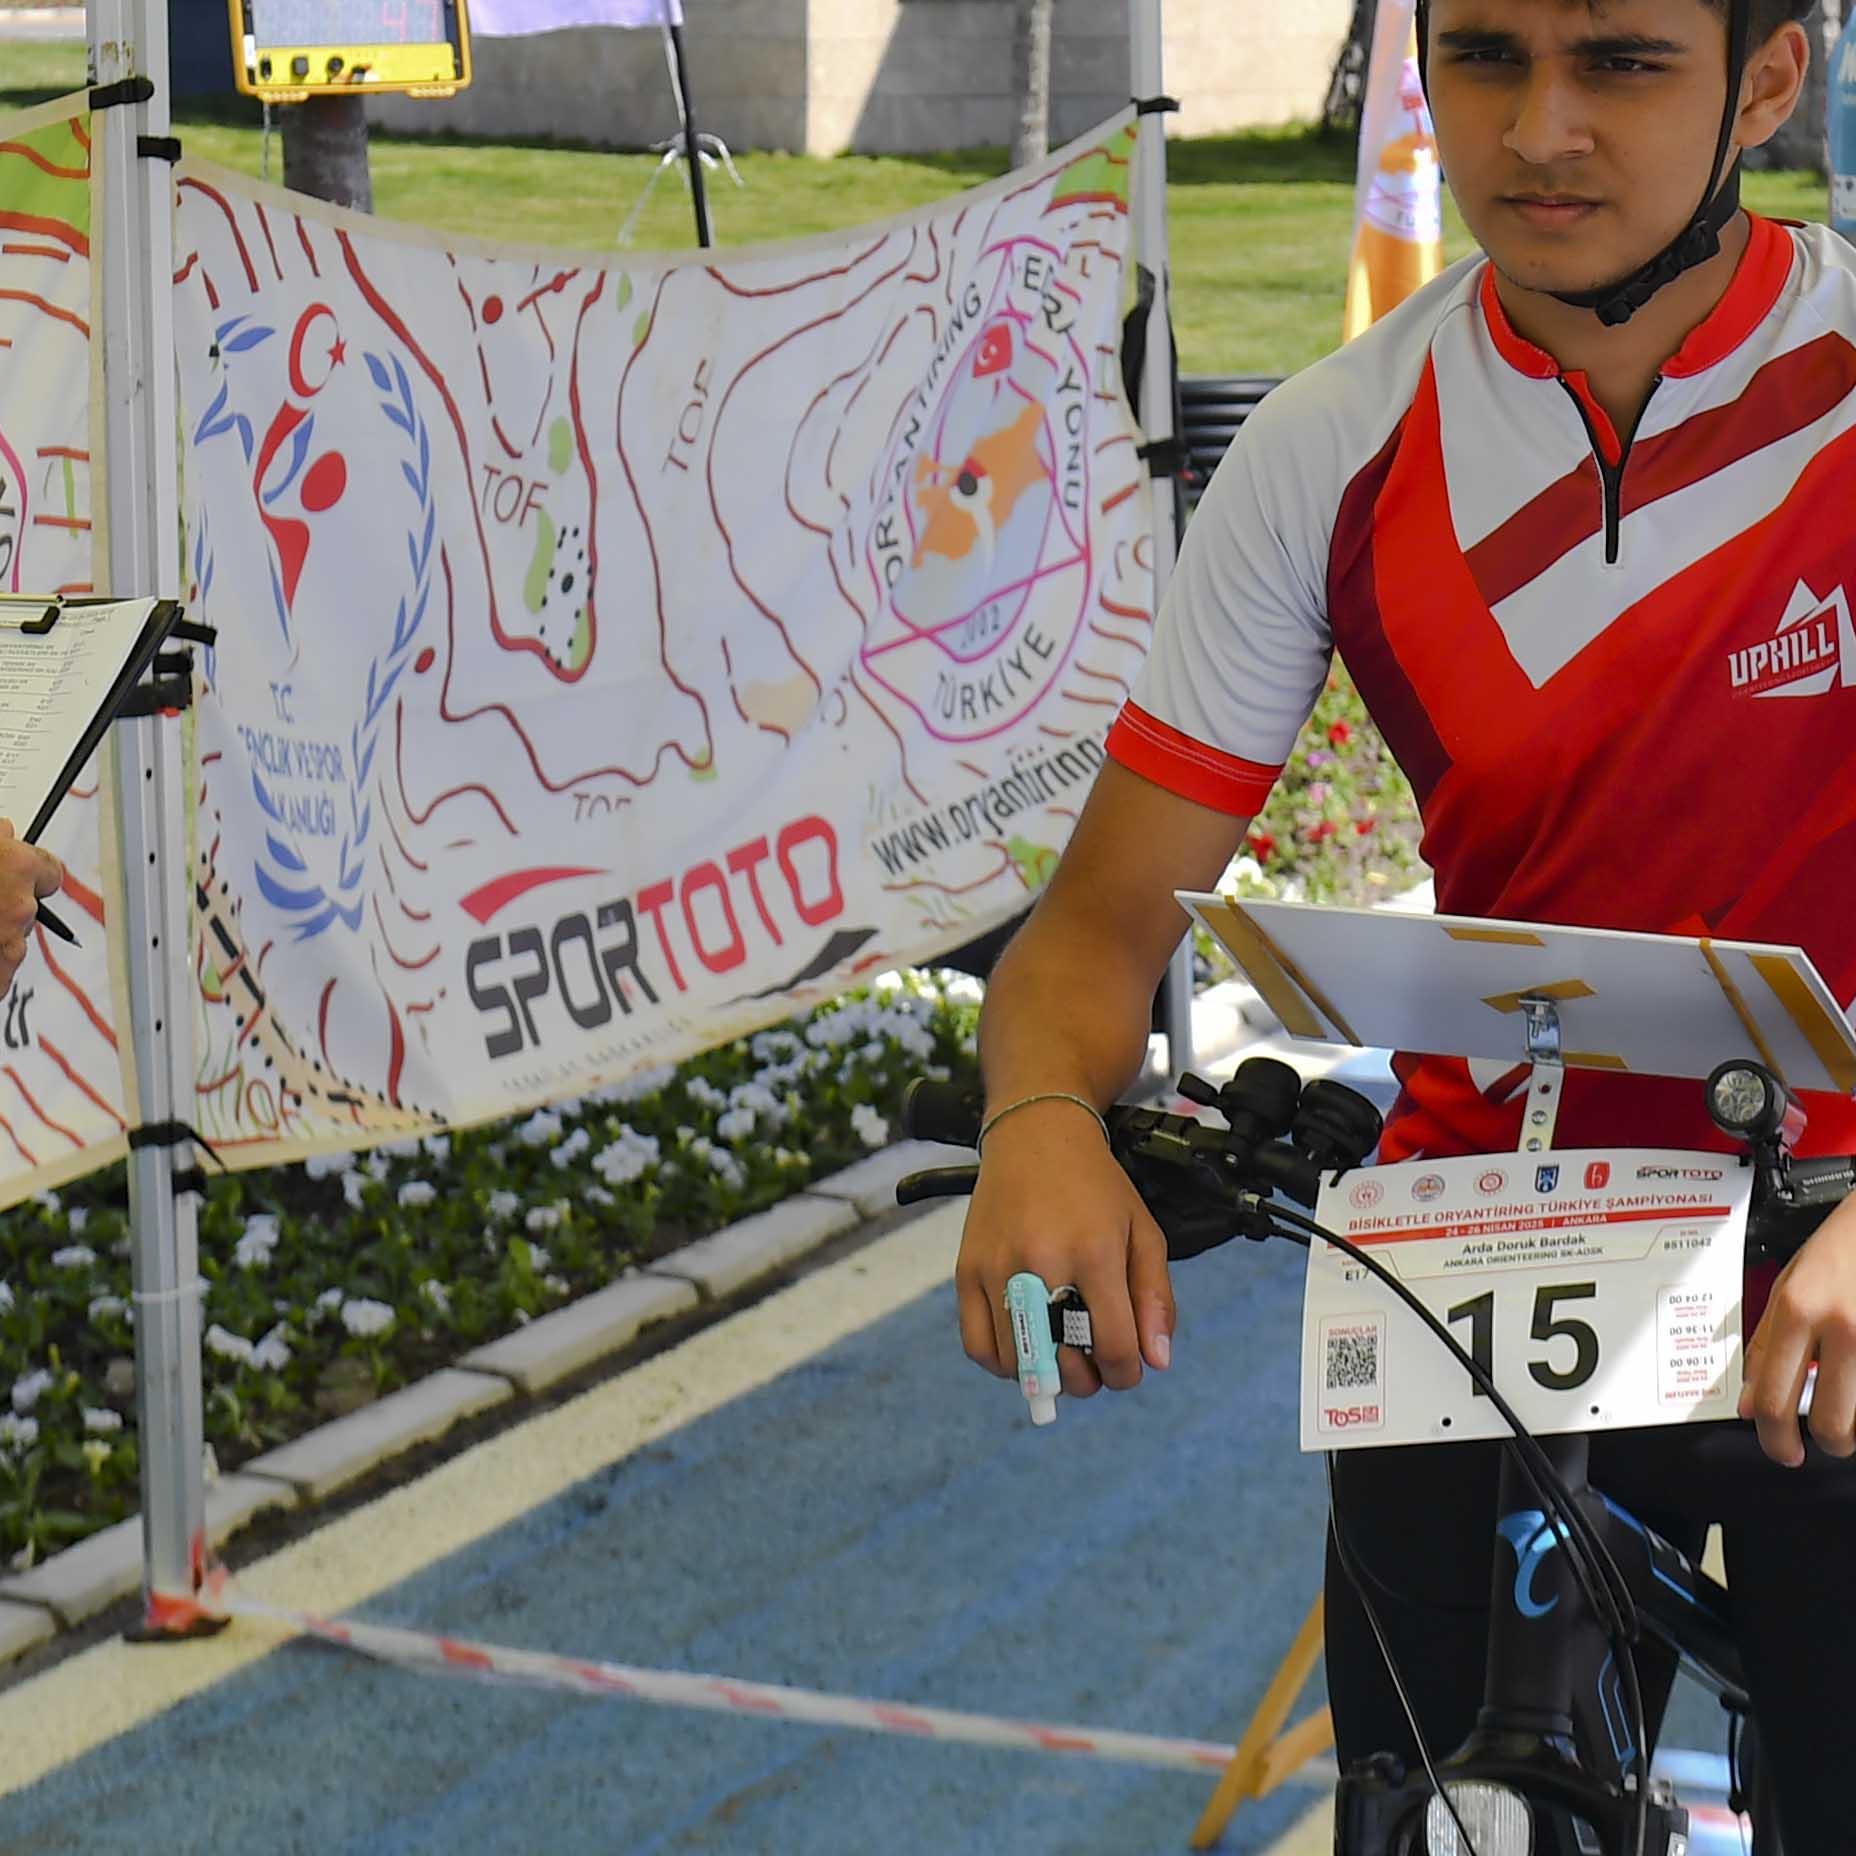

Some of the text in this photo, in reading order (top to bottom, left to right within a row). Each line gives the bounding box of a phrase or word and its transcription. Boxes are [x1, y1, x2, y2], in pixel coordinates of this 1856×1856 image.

[481, 464, 550, 530] TOF
[1727, 621, 1836, 688] UPHILL
[1348, 1192, 1715, 1233] BİSİKLETLE ORYANTİRİNG TÜRKİYE ŞAMPİYONASI
[1562, 1213, 1608, 1227] ANKARA
[1443, 1256, 1485, 1269] ANKARA
[1461, 1233, 1587, 1255] Arda Doruk Bardak
[1447, 1281, 1599, 1398] 15
